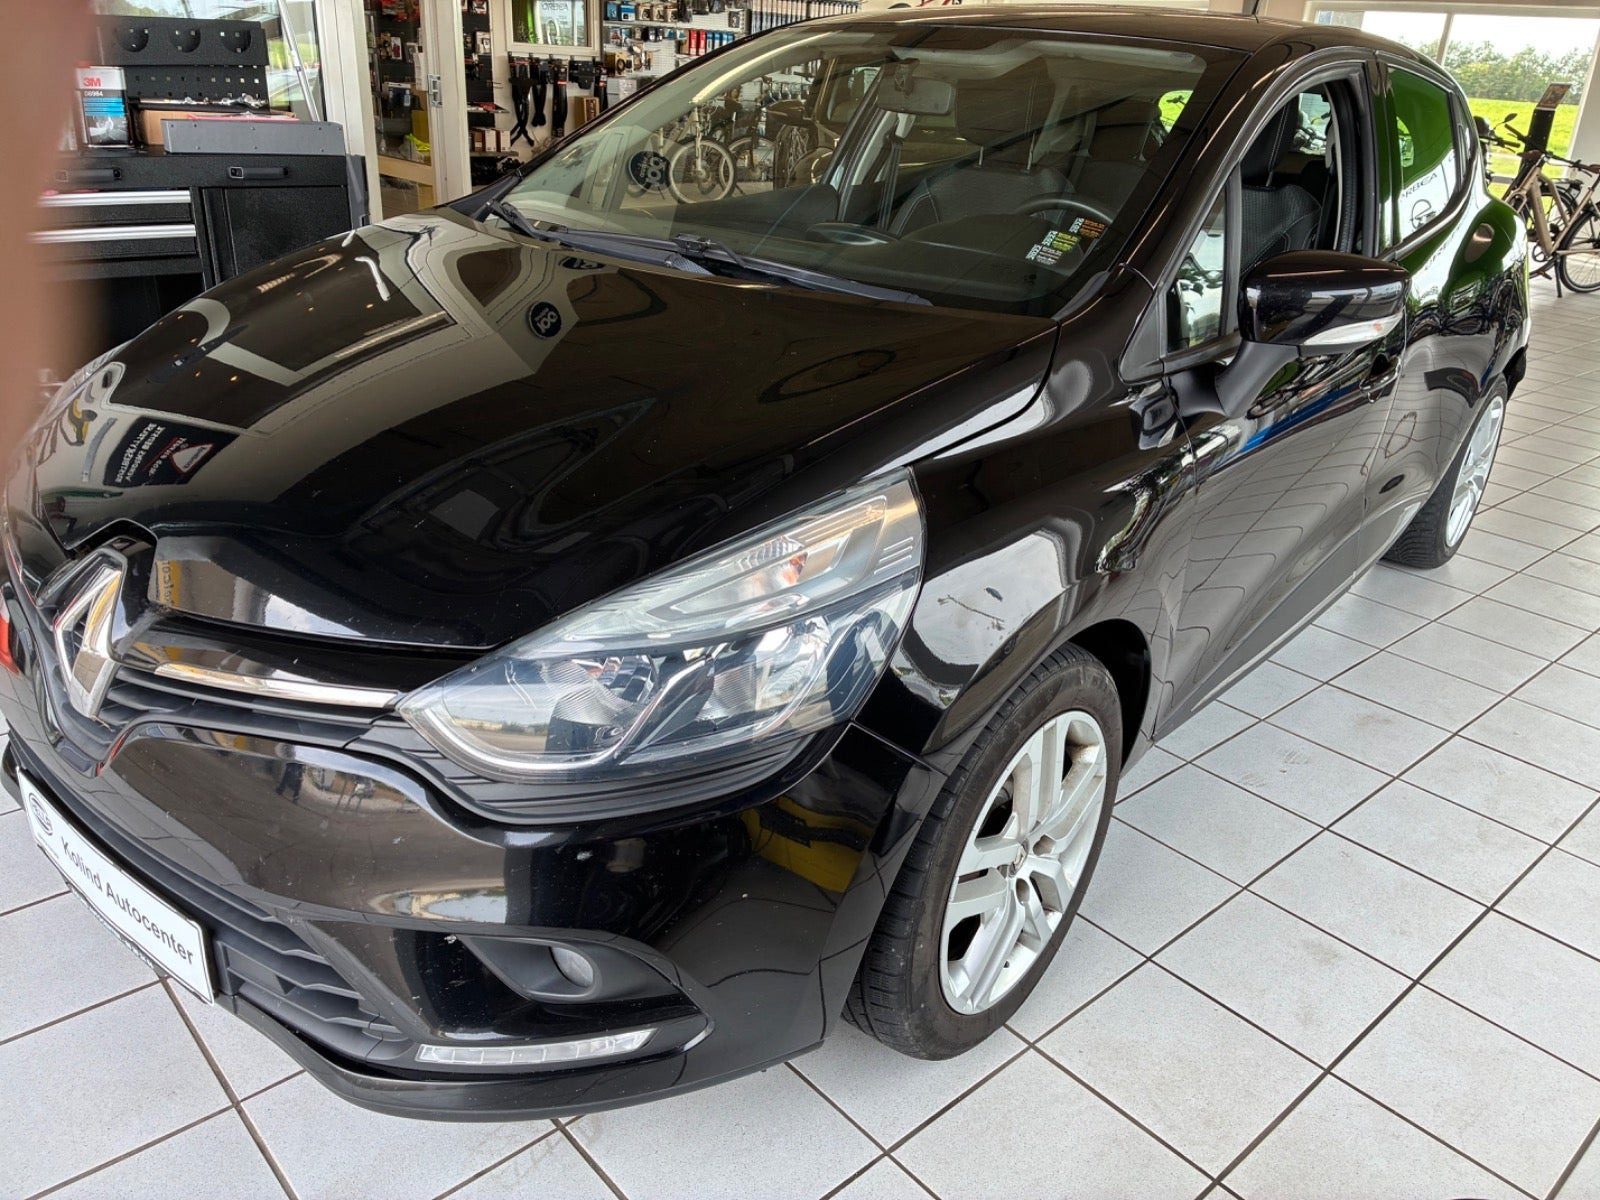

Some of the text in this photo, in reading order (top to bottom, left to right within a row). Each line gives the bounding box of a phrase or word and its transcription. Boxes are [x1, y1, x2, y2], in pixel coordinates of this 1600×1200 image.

[83, 77, 102, 87] 3M
[61, 836, 103, 892] Kolind
[106, 881, 194, 965] Autocenter
